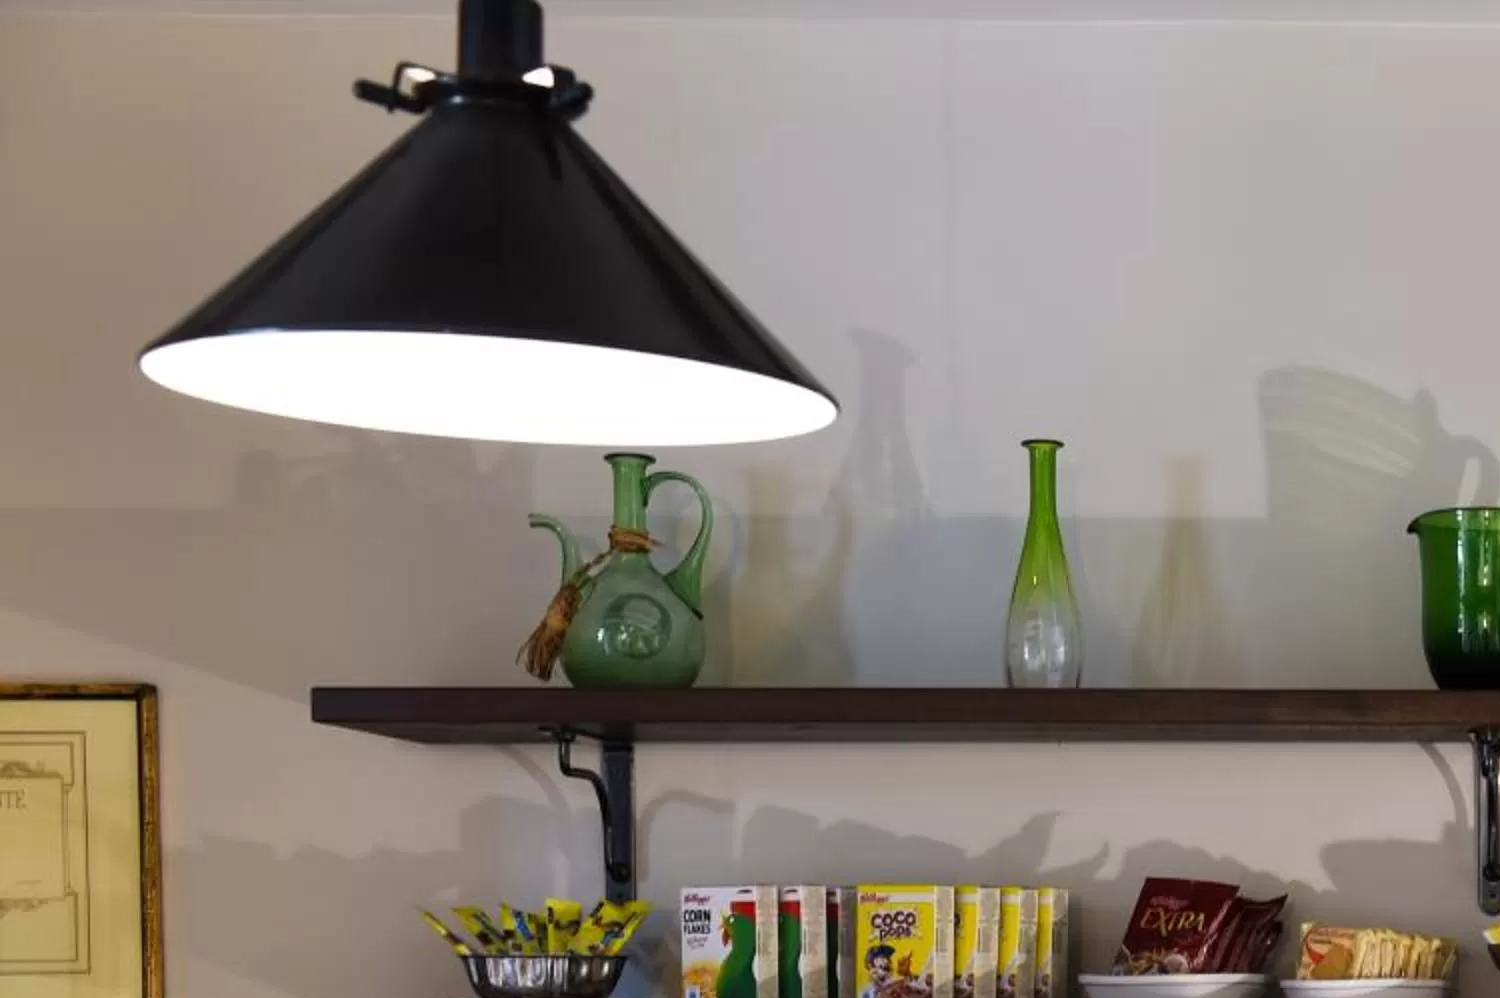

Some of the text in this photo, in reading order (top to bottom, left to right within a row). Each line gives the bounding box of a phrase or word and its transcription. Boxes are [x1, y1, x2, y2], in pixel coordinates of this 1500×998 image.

[683, 909, 711, 923] CORN
[1139, 907, 1206, 937] EXTRA
[683, 924, 711, 936] FLAKES
